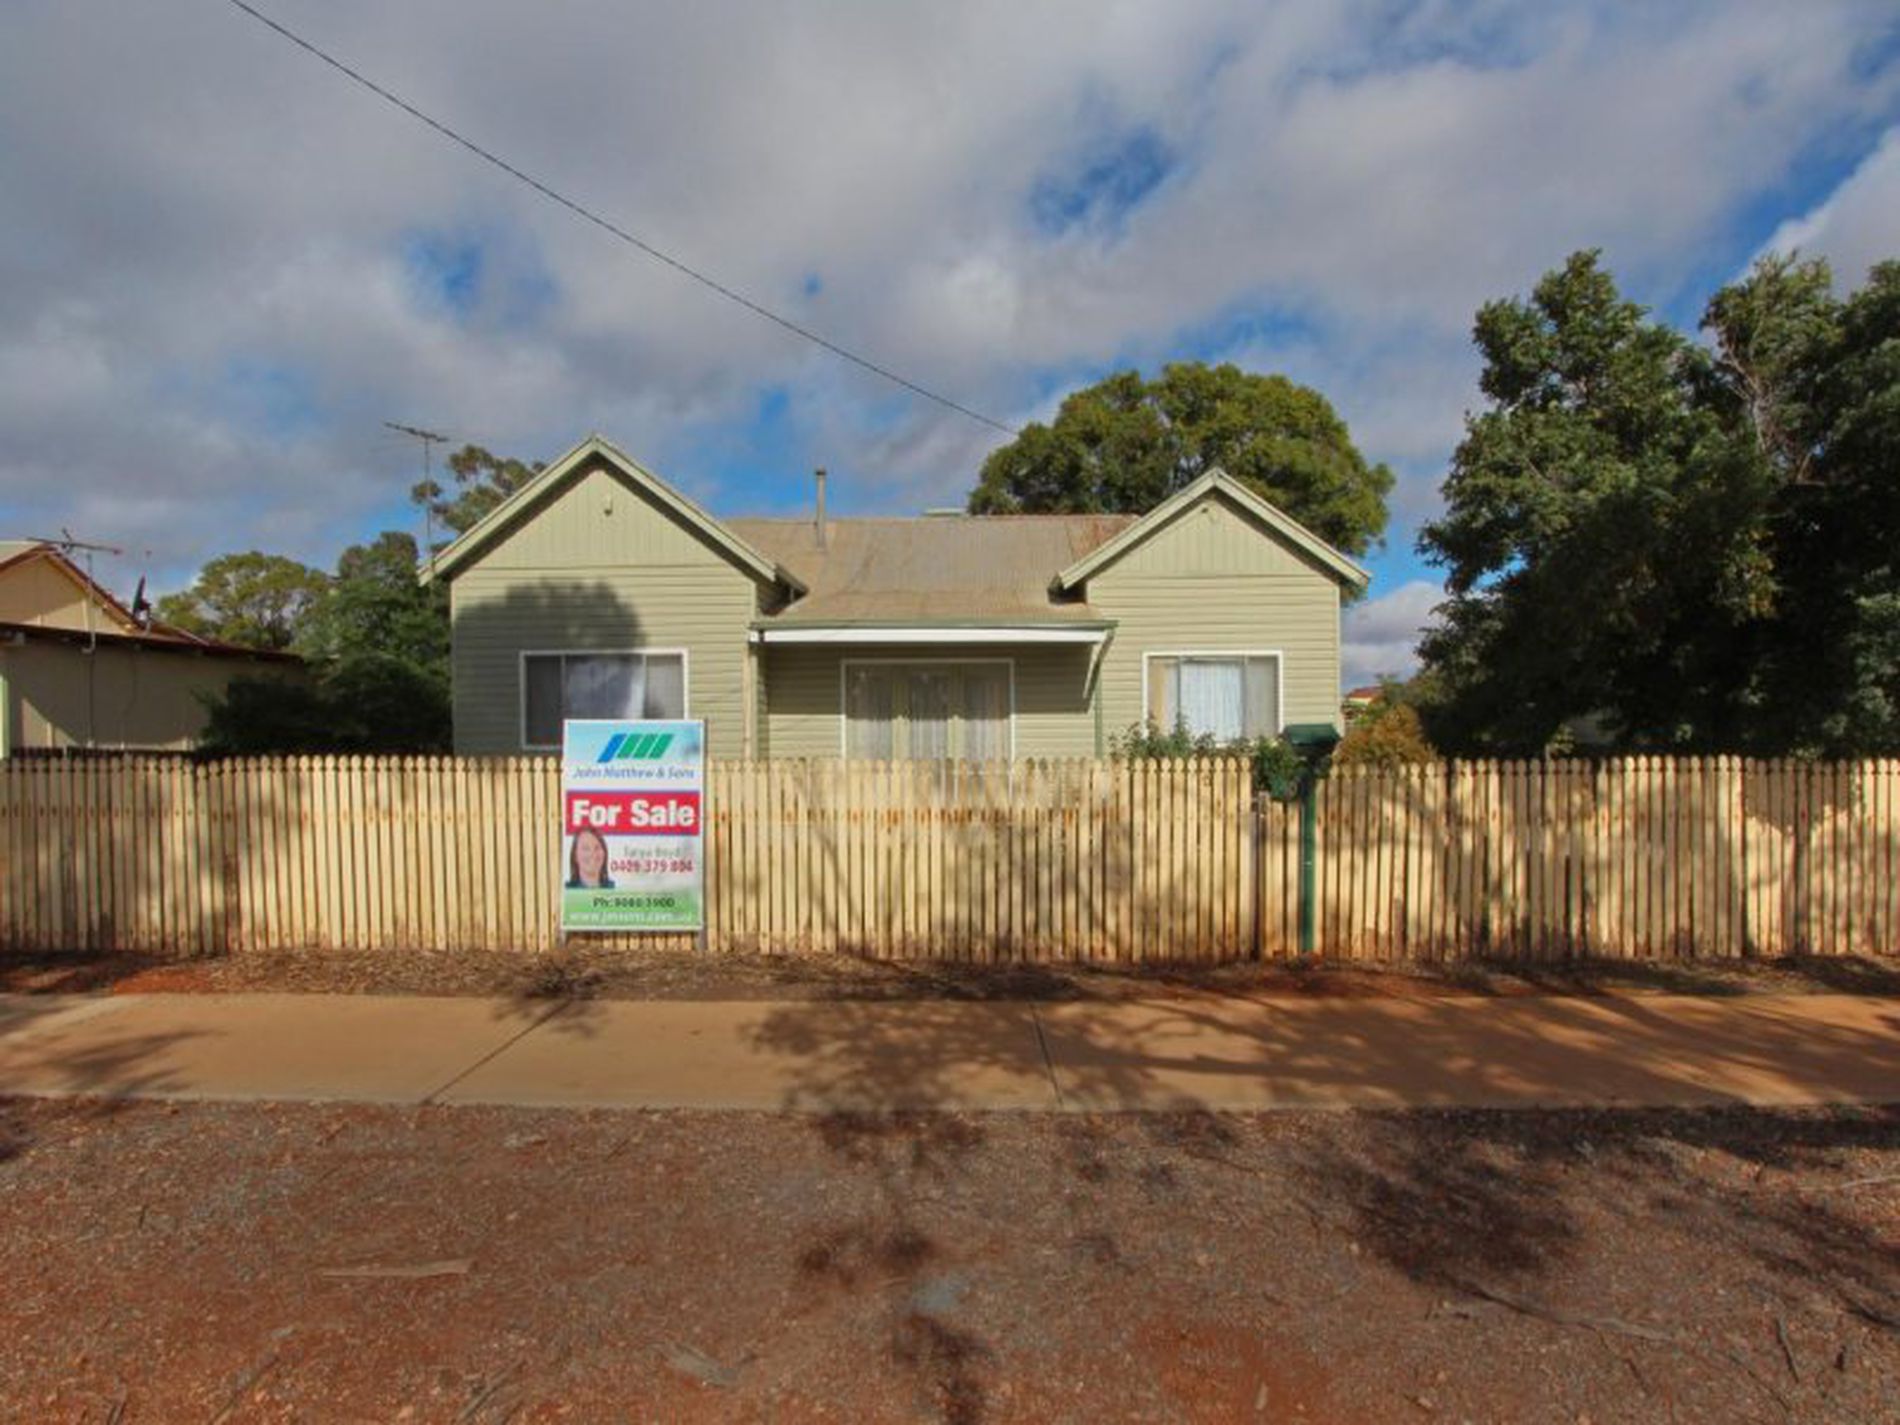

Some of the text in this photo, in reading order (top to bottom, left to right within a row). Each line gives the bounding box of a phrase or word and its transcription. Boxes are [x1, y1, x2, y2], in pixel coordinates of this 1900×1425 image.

[603, 766, 653, 779] Matthew
[655, 767, 665, 778] &
[572, 799, 695, 827] For Sale
